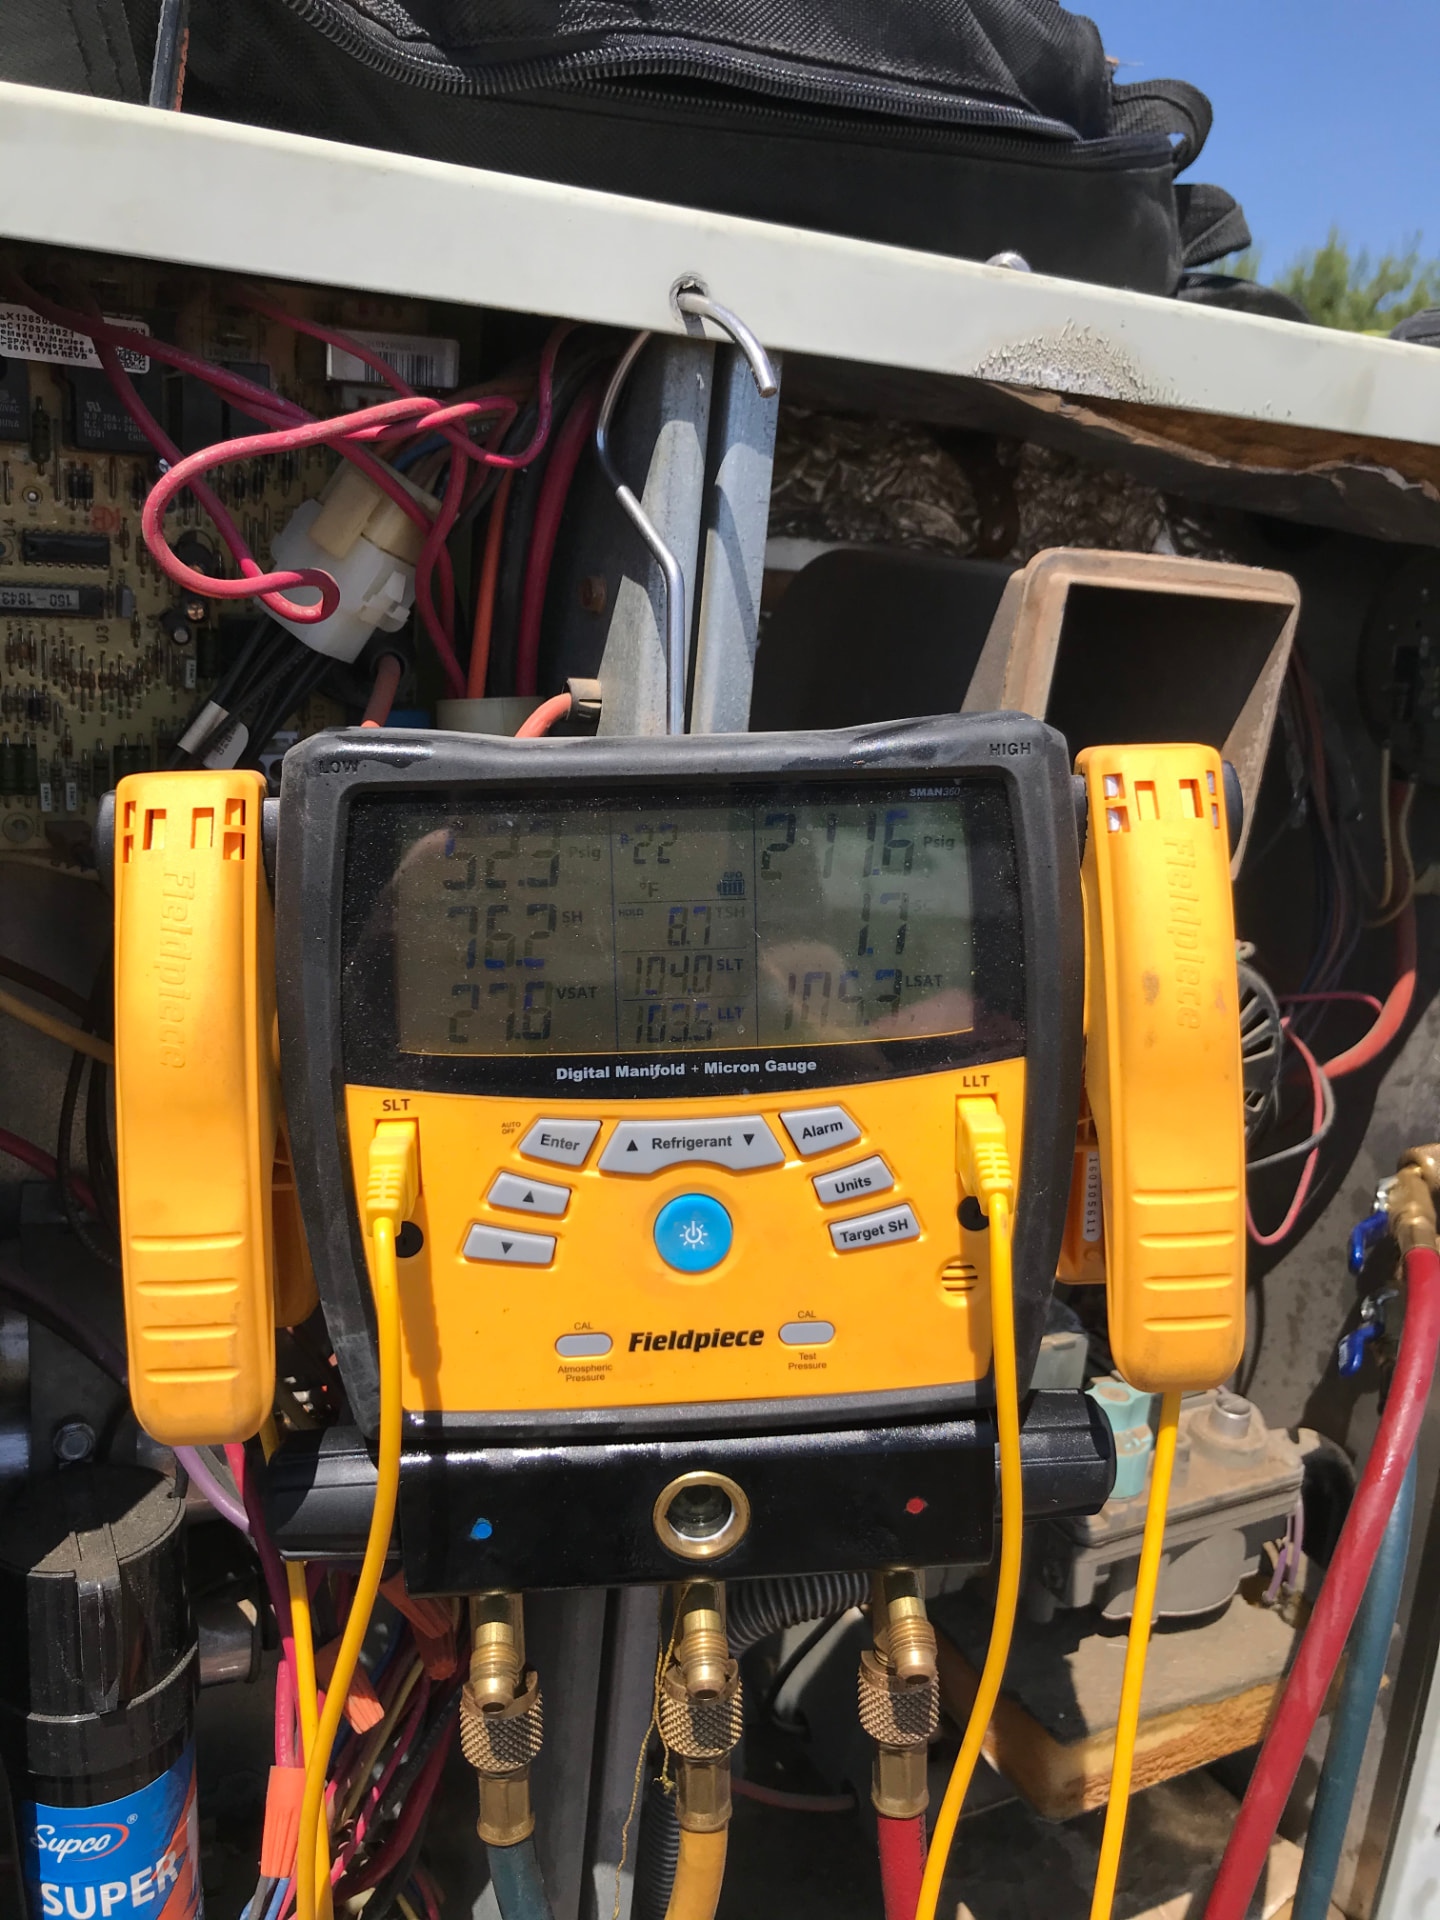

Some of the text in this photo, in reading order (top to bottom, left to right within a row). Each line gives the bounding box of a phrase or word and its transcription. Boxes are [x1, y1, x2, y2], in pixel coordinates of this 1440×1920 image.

[989, 742, 1031, 756] HIGH
[319, 760, 359, 774] LOW
[924, 835, 955, 850] Psig
[562, 910, 583, 924] SH
[618, 908, 644, 917] HOLD
[715, 906, 745, 919] TSH
[717, 958, 744, 971] SLT
[905, 974, 943, 988] LSAT
[556, 986, 597, 1000] VSAT
[717, 1006, 744, 1020] LLT
[556, 1065, 610, 1082] Digital
[615, 1063, 685, 1079] Manifold
[704, 1060, 760, 1075] Micron
[764, 1059, 817, 1074] Gauge
[962, 1075, 990, 1088] LLT
[382, 1098, 410, 1111] SLT
[501, 1121, 521, 1129] AUTO
[501, 1127, 515, 1135] OFF
[802, 1119, 843, 1140] Alarm
[540, 1133, 580, 1151] Enter
[651, 1135, 732, 1152] Refrigerant
[834, 1177, 872, 1194] Units
[840, 1218, 909, 1243] Target SH
[797, 1310, 816, 1319] CAL
[574, 1322, 593, 1330] CAL
[628, 1328, 765, 1352] Fieldpiece
[799, 1352, 817, 1361] Test
[557, 1363, 613, 1374] Atmospheric
[788, 1361, 827, 1371] Pressure
[565, 1373, 606, 1383] Pressure
[29, 1824, 112, 1864] Supco
[41, 1850, 178, 1920] SUPER
